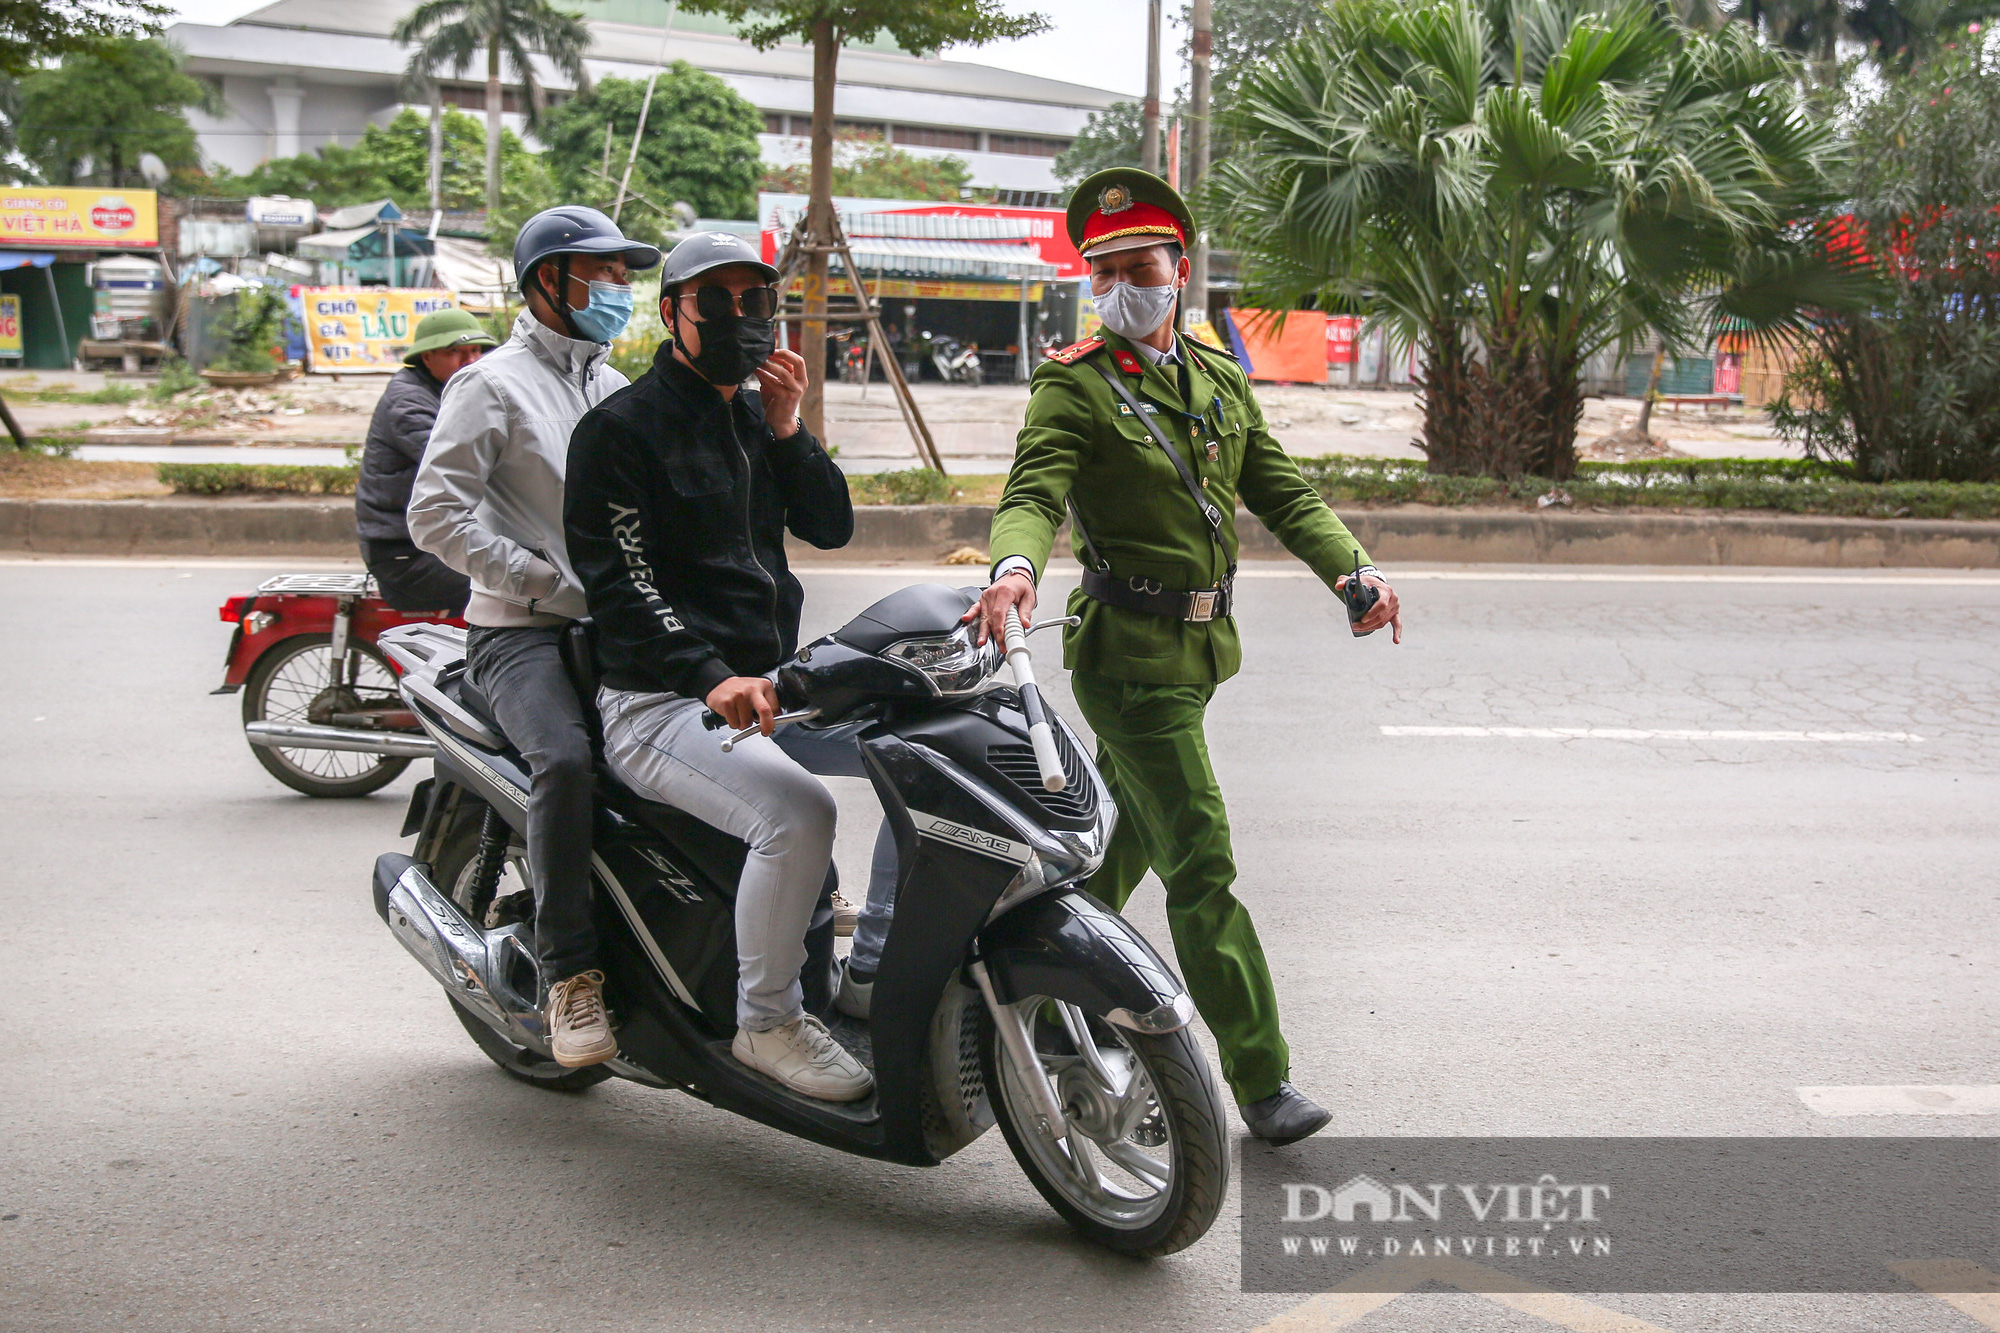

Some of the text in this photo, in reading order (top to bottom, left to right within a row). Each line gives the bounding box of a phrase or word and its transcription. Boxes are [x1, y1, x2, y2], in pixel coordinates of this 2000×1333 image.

[2, 212, 83, 235] VIỆT HÀ
[317, 300, 357, 315] CHÓ
[323, 346, 350, 361] VỊT
[494, 774, 527, 803] AMG
[954, 827, 1011, 854] AMG
